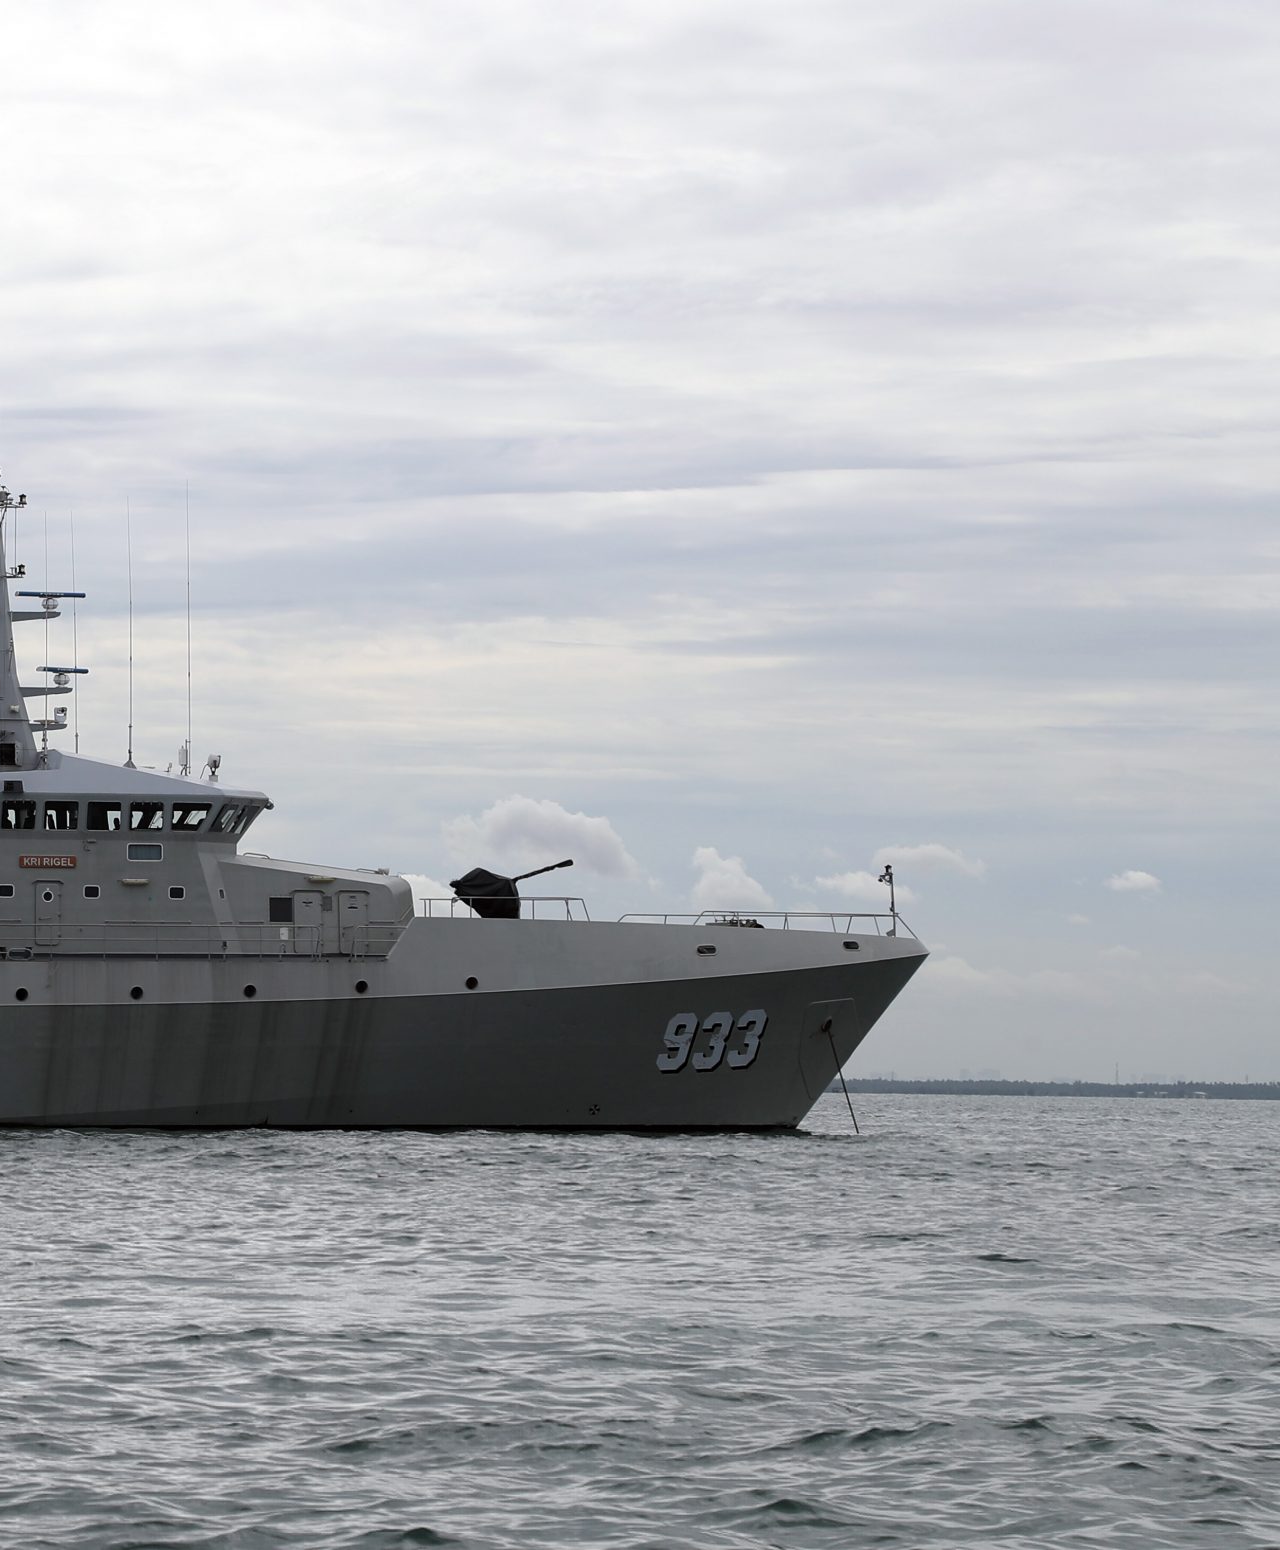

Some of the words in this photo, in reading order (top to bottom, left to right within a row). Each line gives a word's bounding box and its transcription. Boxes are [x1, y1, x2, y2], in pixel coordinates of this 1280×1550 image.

[23, 857, 41, 866] KRI
[43, 857, 74, 867] RIGEL
[656, 1009, 769, 1074] 933
